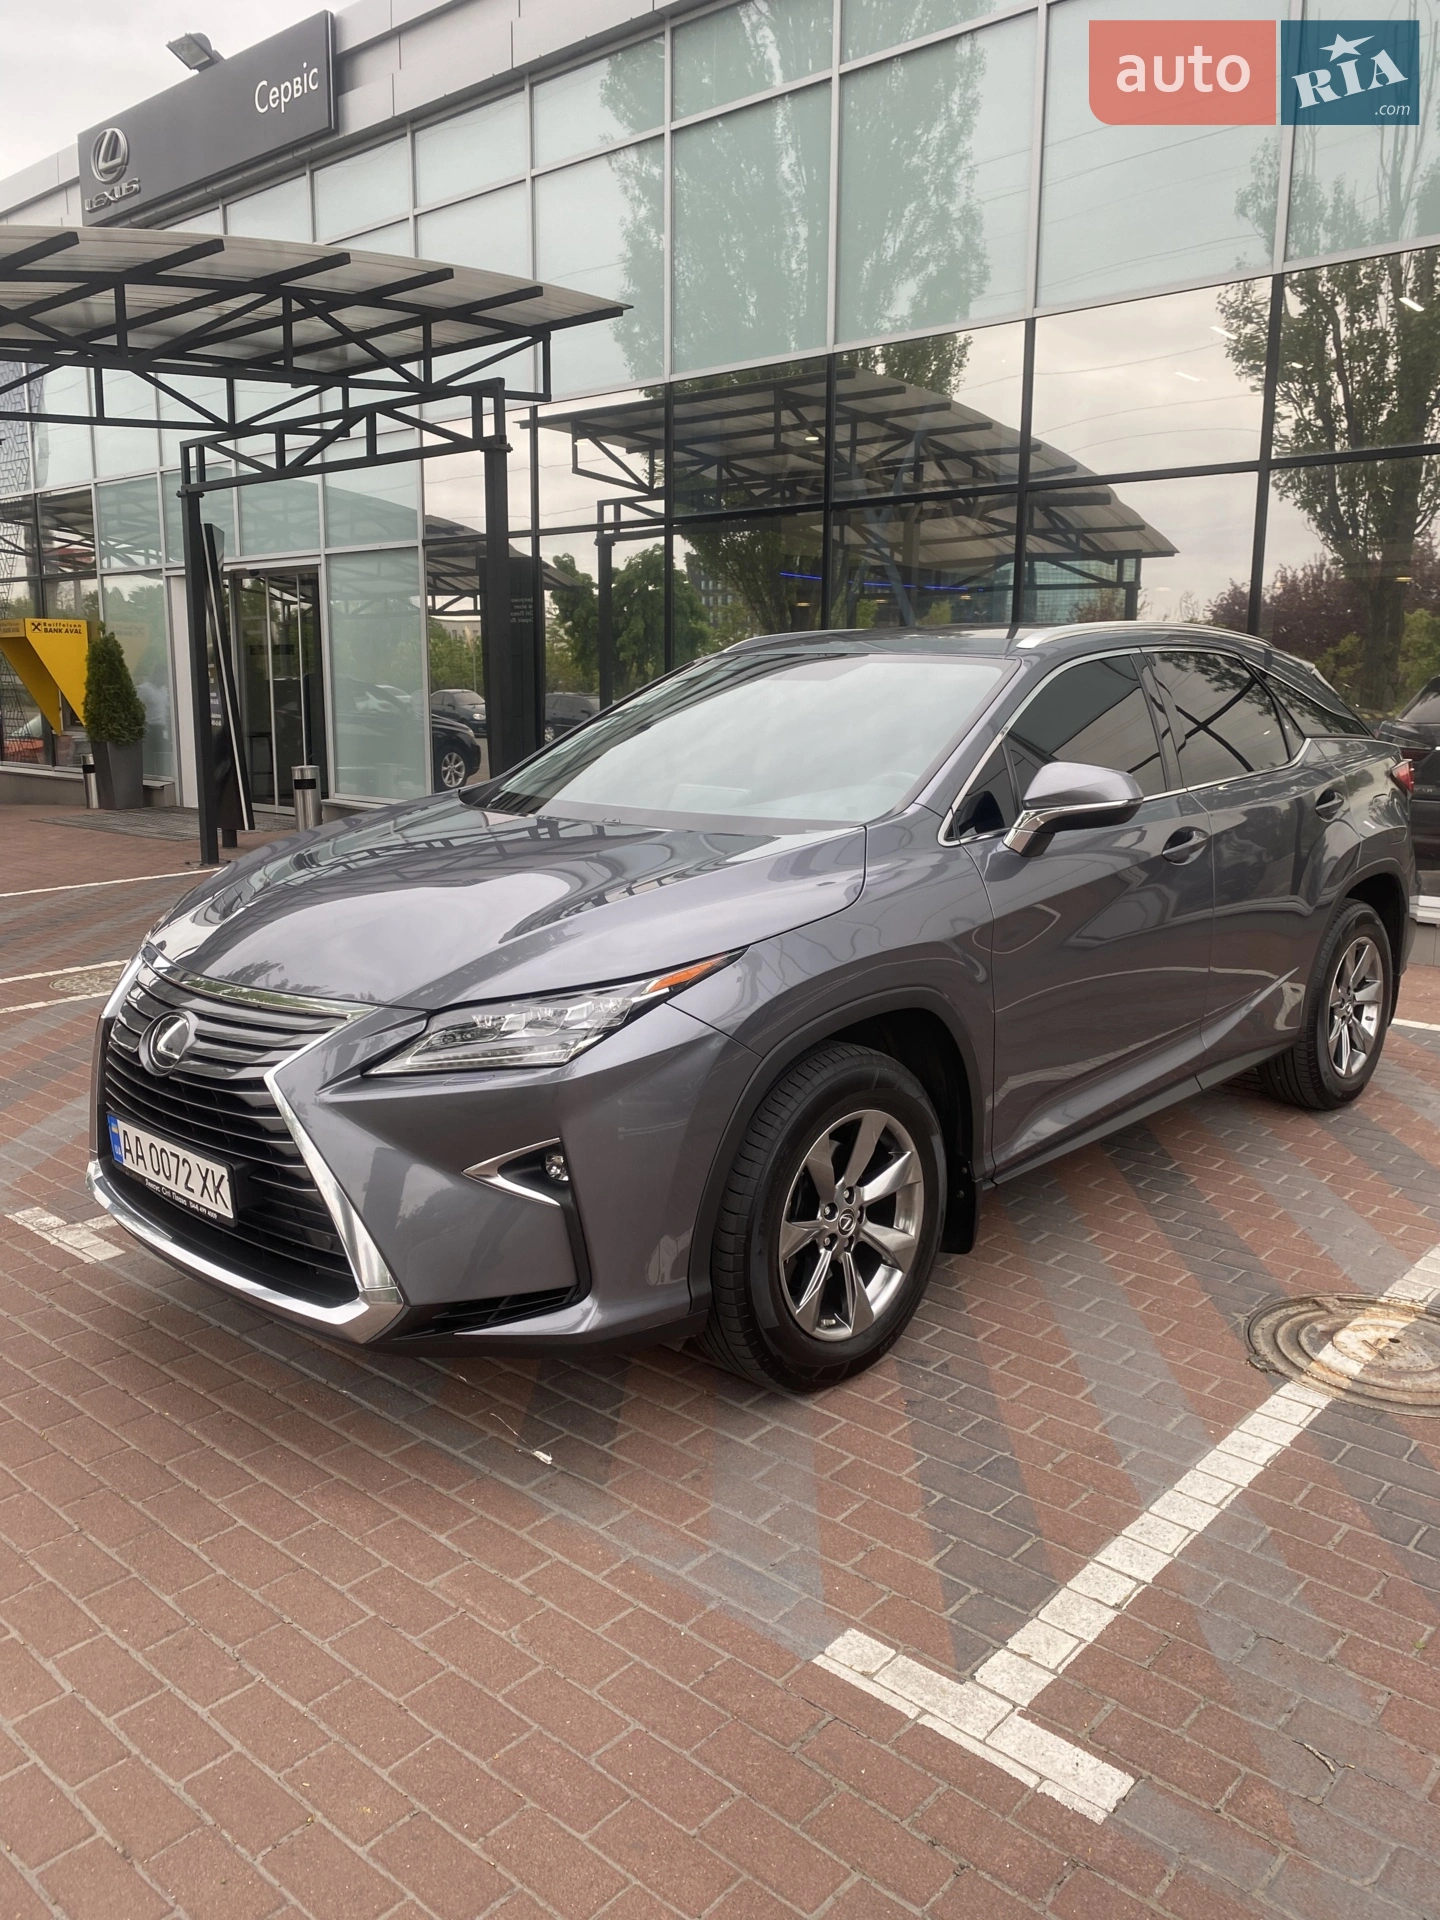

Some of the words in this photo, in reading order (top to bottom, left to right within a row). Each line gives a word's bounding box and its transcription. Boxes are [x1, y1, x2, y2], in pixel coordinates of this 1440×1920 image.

[254, 61, 319, 114] Сервіс
[84, 177, 141, 213] LEXUS
[122, 1129, 148, 1172] AA
[148, 1141, 195, 1195] 0072
